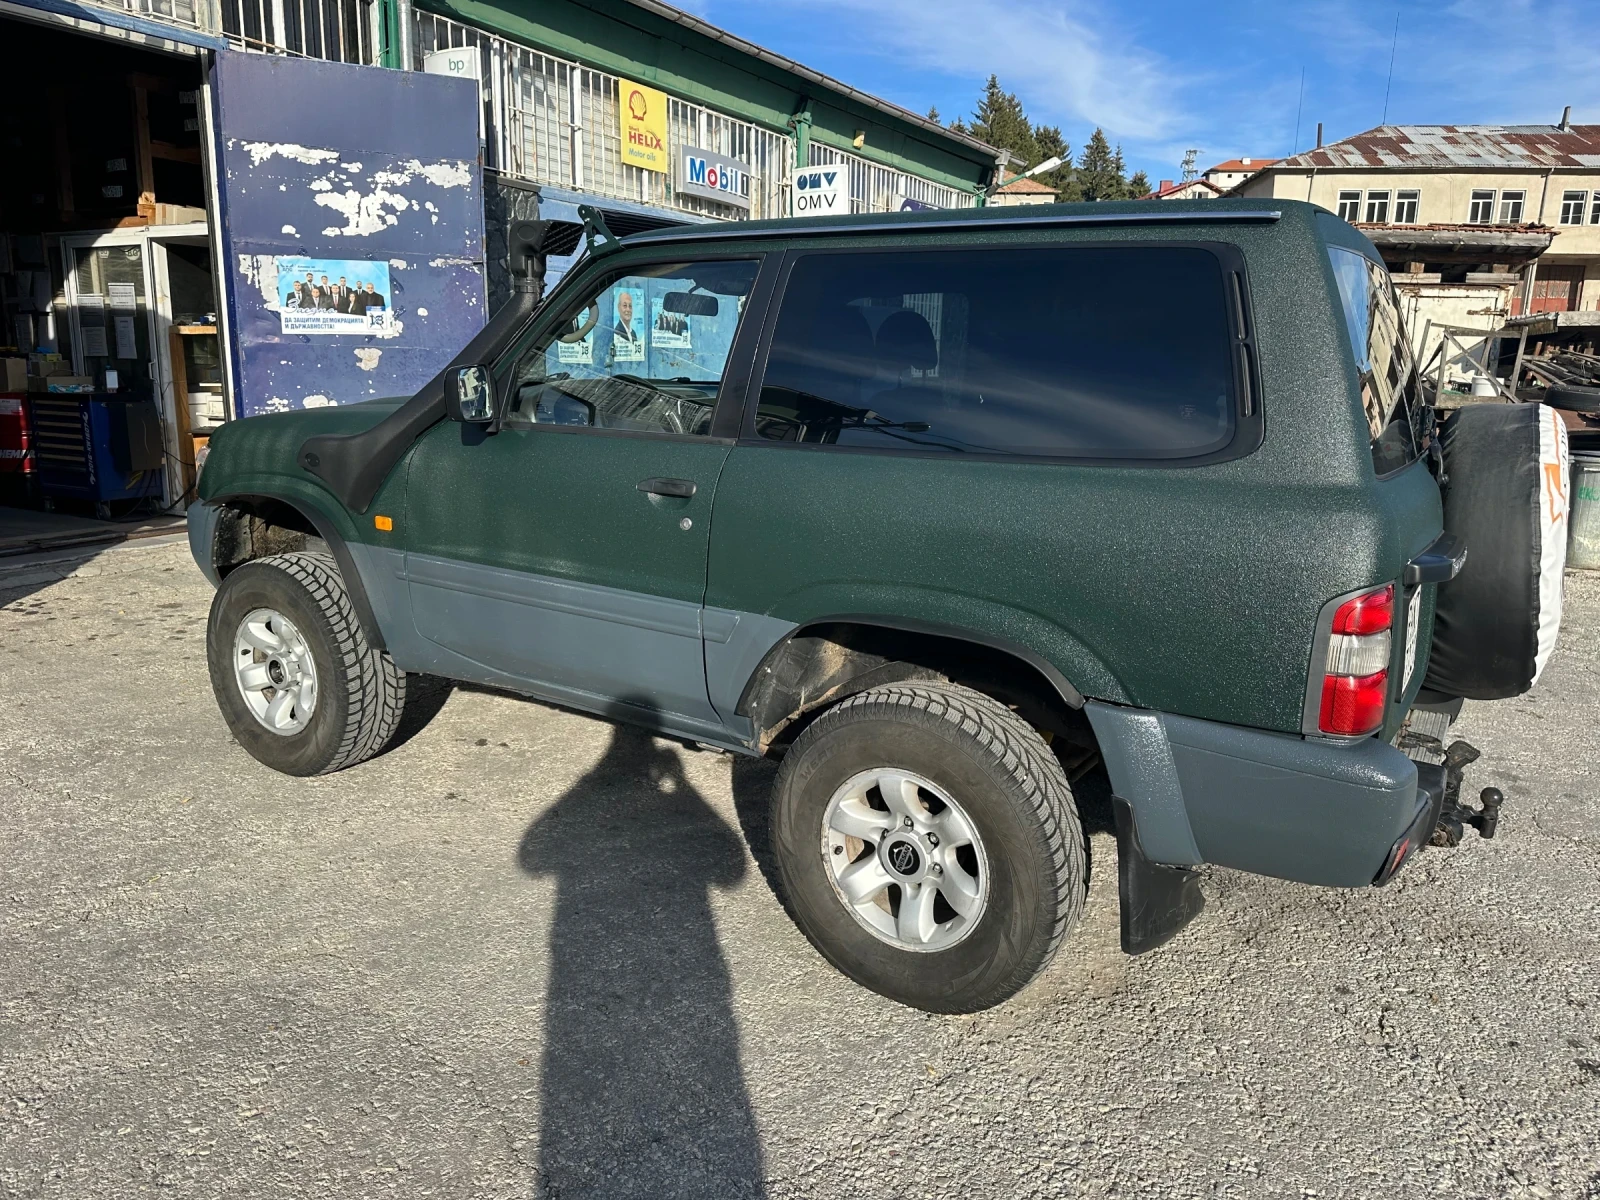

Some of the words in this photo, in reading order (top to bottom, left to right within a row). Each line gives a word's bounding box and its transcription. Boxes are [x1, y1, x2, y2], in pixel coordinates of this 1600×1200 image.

[448, 58, 465, 73] bp
[628, 130, 664, 151] HELIX
[628, 148, 646, 159] Motor
[646, 152, 657, 162] oils
[688, 156, 739, 193] Mobil
[797, 193, 837, 211] OMV
[321, 317, 364, 325] ДЕМОКРАЦИЯТА
